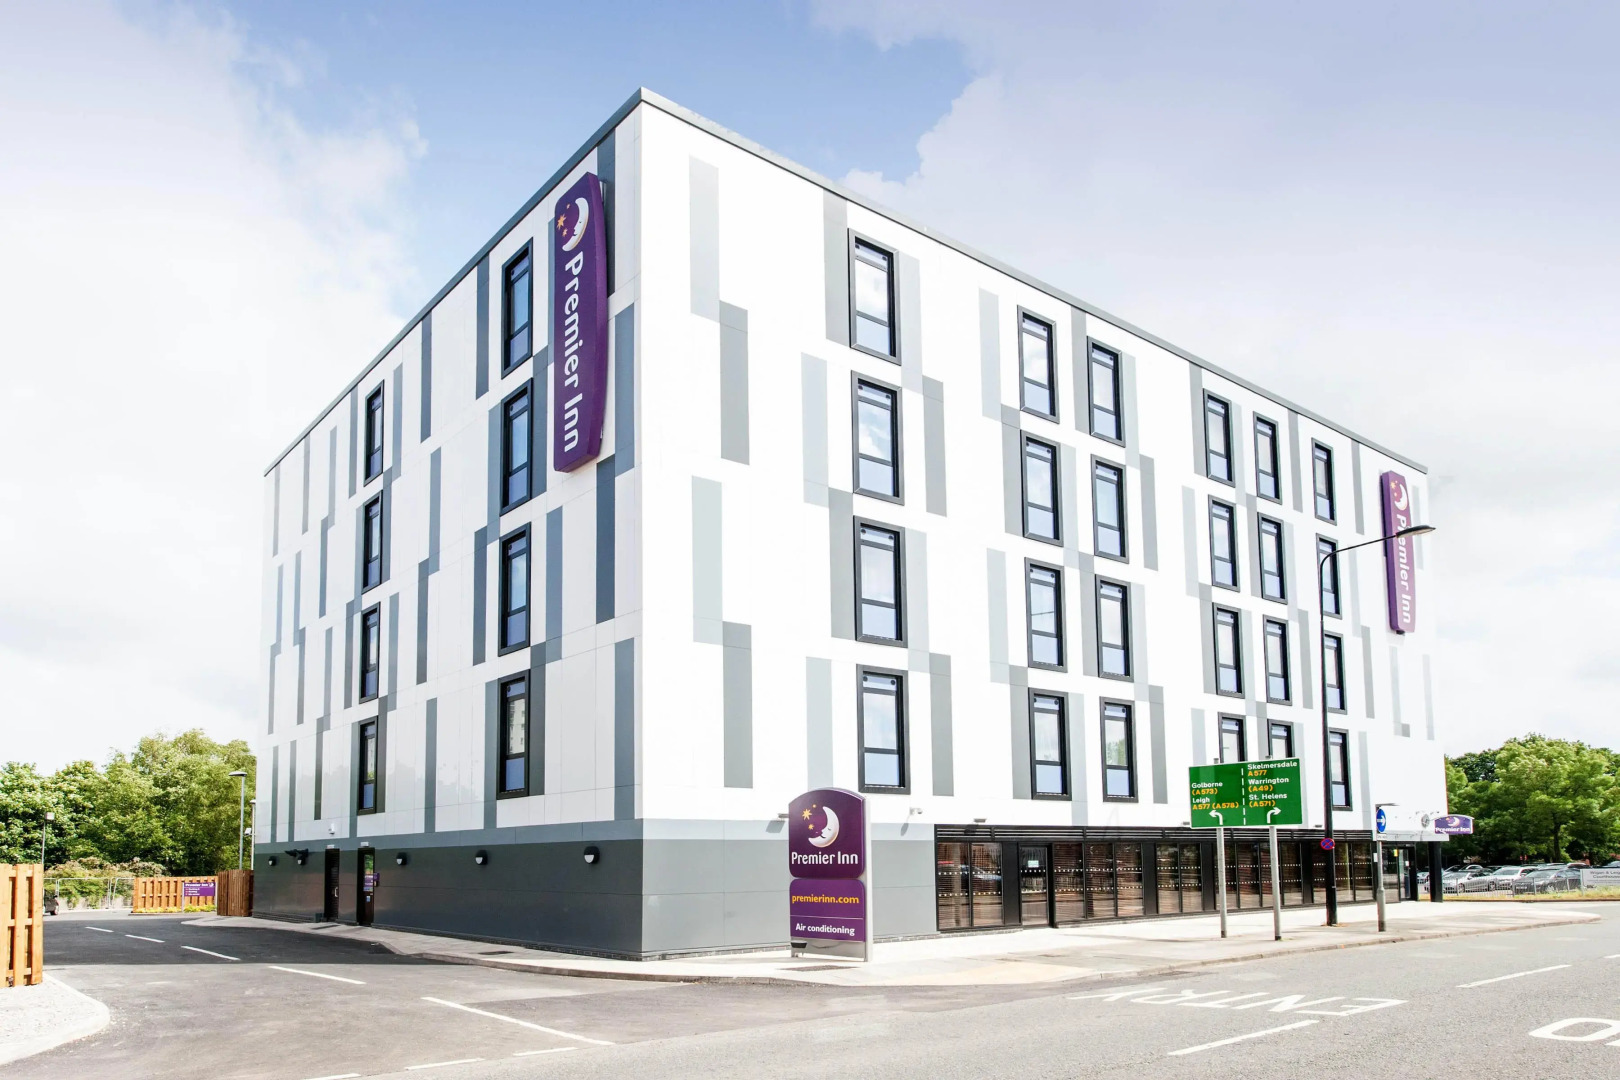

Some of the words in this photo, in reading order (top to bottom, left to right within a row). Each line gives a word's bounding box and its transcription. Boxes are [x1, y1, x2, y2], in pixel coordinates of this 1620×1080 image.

[564, 251, 584, 388] Premier
[564, 393, 583, 452] Inn
[1402, 594, 1411, 623] Inn
[1247, 760, 1298, 770] Skelmersdale
[1191, 781, 1223, 789] Golborne
[1248, 777, 1290, 785] Warrington
[1192, 796, 1210, 804] Leigh
[1248, 793, 1260, 801] St.
[791, 851, 836, 865] Premier
[837, 850, 859, 865] Inn
[791, 893, 860, 904] premierinn.com
[795, 922, 807, 931] Air
[807, 923, 856, 936] conditioning
